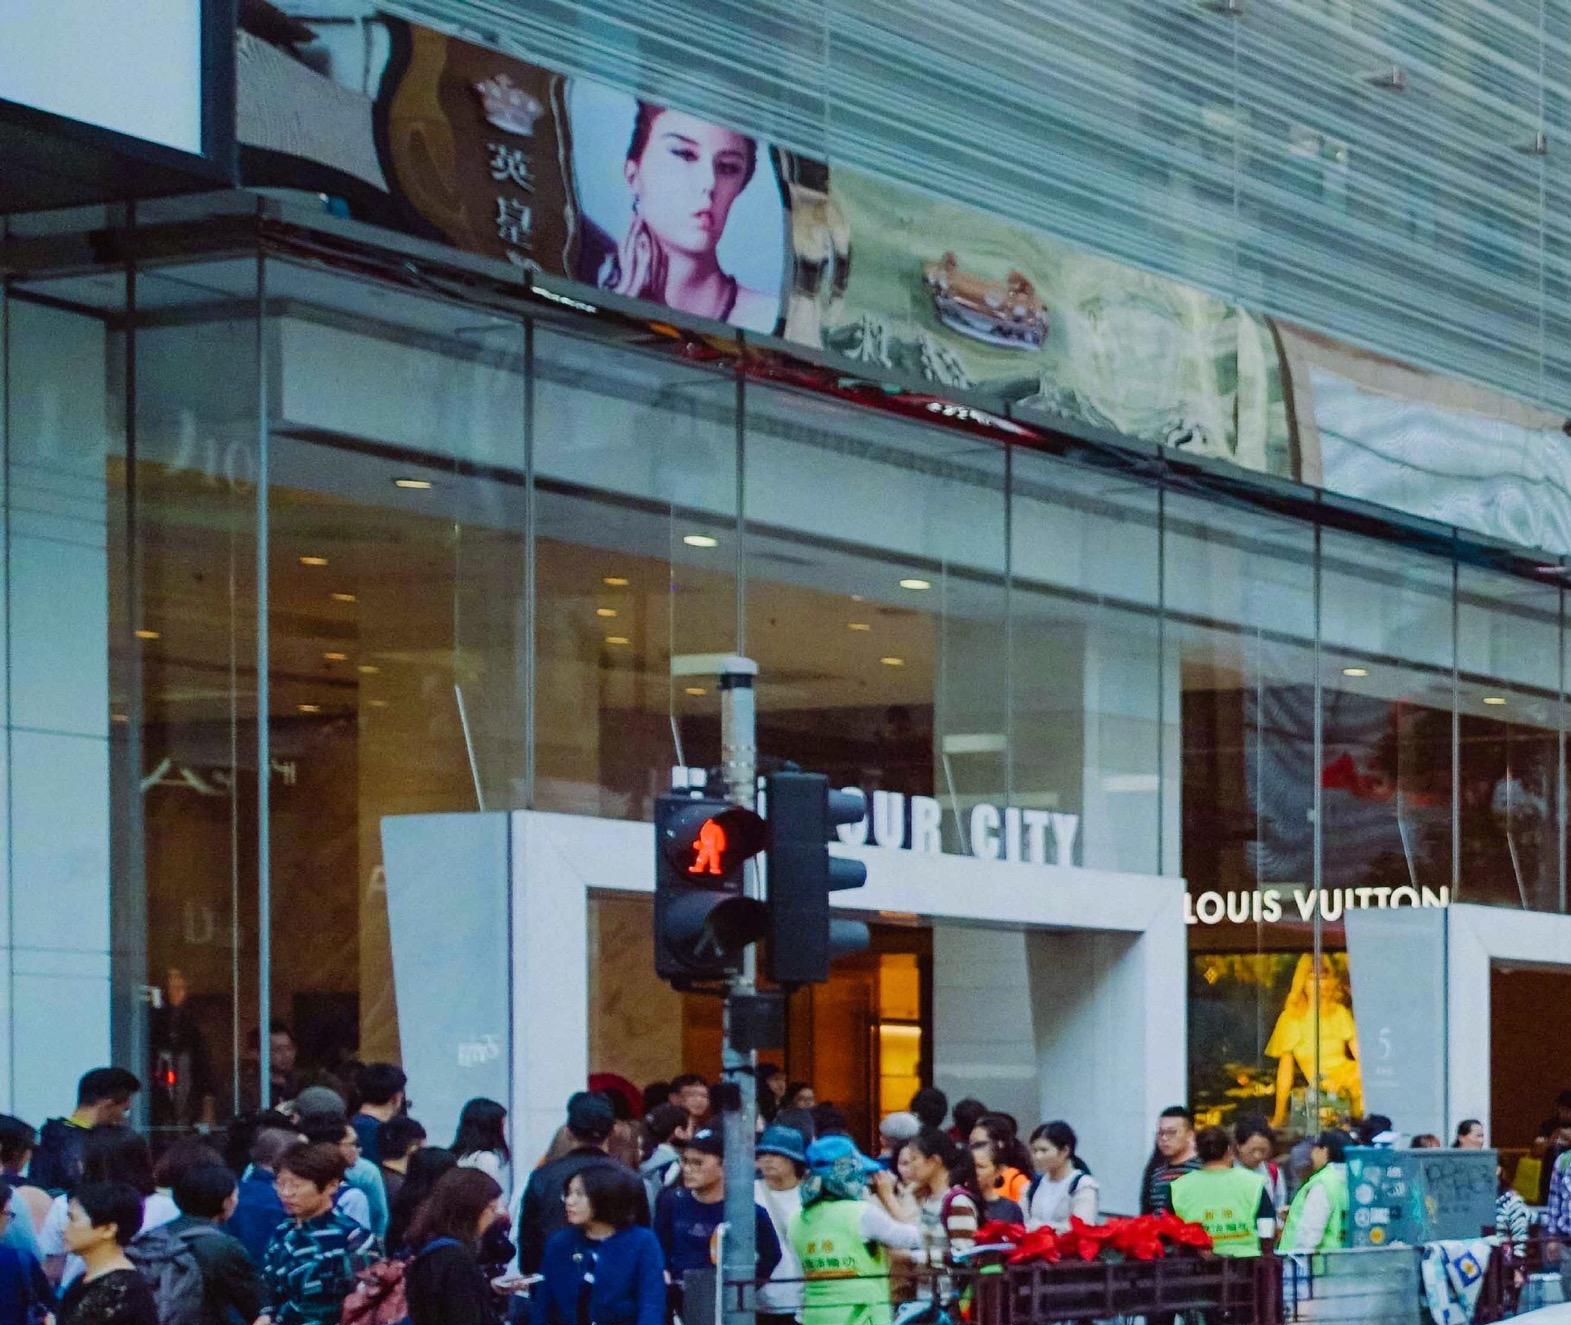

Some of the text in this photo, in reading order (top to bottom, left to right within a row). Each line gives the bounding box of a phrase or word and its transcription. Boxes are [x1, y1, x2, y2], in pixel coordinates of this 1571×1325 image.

[970, 803, 1079, 866] CITY
[1184, 885, 1450, 925] LOUIS VUITTON
